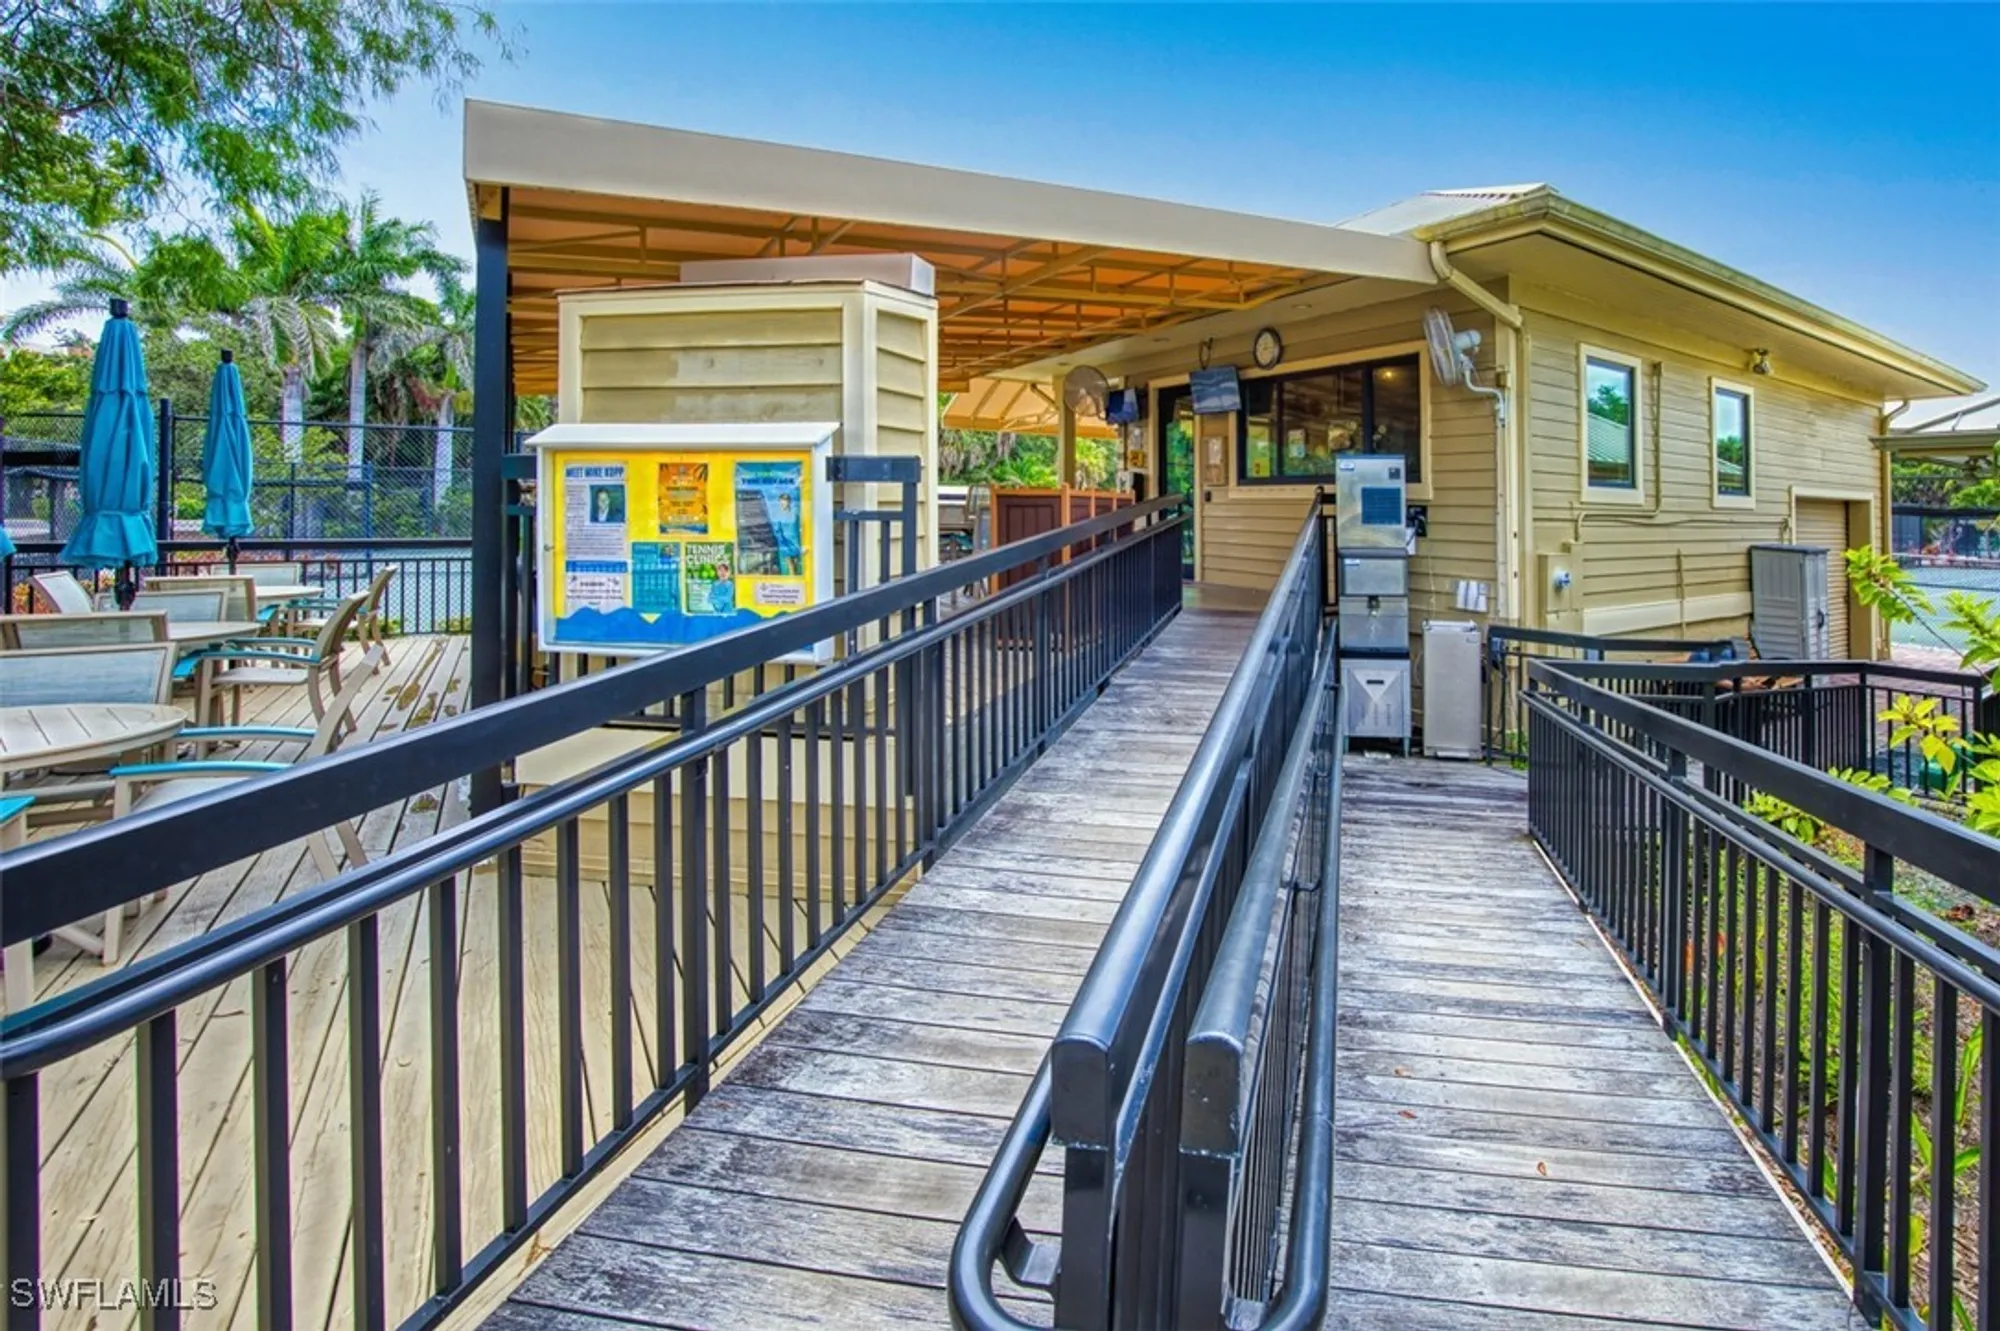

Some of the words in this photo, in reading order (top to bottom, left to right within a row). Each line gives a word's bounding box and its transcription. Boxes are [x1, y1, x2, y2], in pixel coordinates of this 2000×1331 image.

[566, 466, 583, 478] MEET
[585, 466, 602, 478] MIKE
[686, 544, 725, 556] TENNIS
[686, 554, 730, 566] CLINICS
